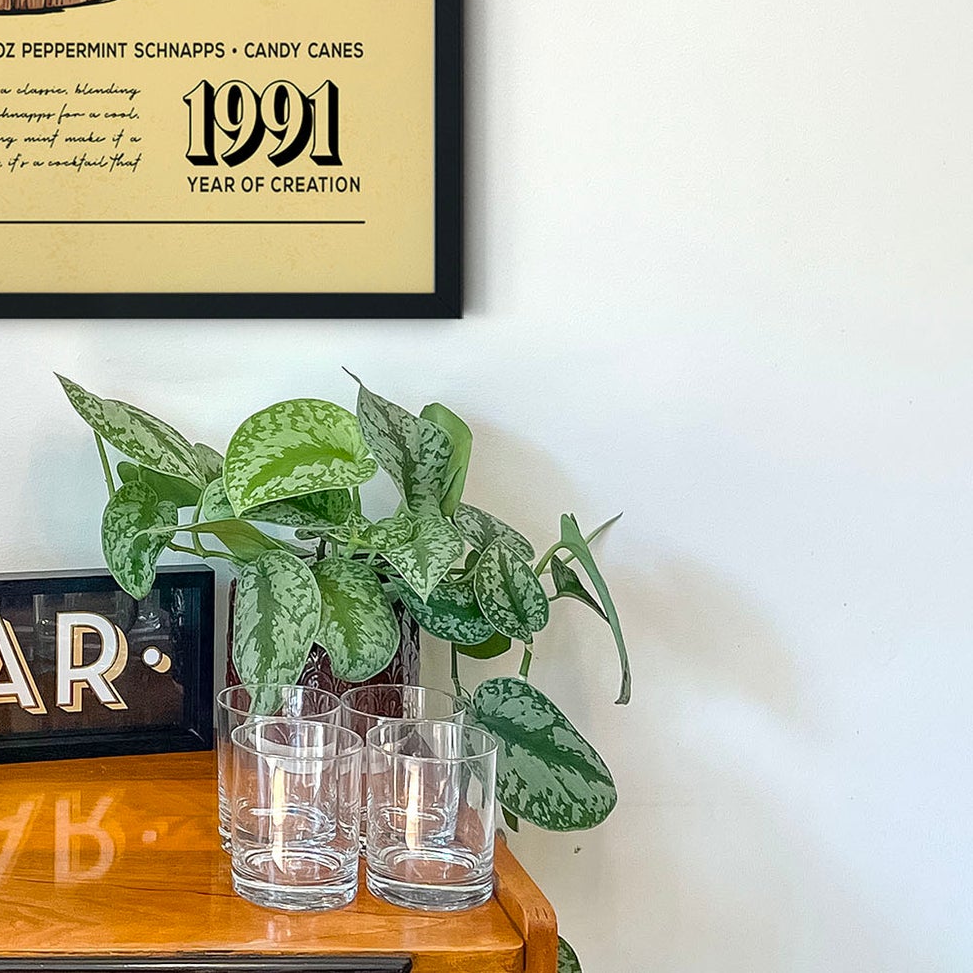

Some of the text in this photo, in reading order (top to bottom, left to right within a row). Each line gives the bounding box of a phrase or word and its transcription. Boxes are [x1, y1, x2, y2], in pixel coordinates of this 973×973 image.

[22, 42, 128, 58] PEPPERMINT
[134, 42, 225, 59] SCHNAPPS
[244, 42, 302, 59] CANDY
[308, 42, 364, 59] CANES
[74, 83, 141, 101] blending
[58, 103, 86, 125] for
[182, 79, 343, 168] 1991
[23, 129, 60, 148] mint
[64, 131, 106, 143] make
[112, 129, 125, 148] it
[48, 154, 109, 172] cocktail
[108, 152, 142, 173] that
[187, 176, 361, 193] YEAR OF CREATION
